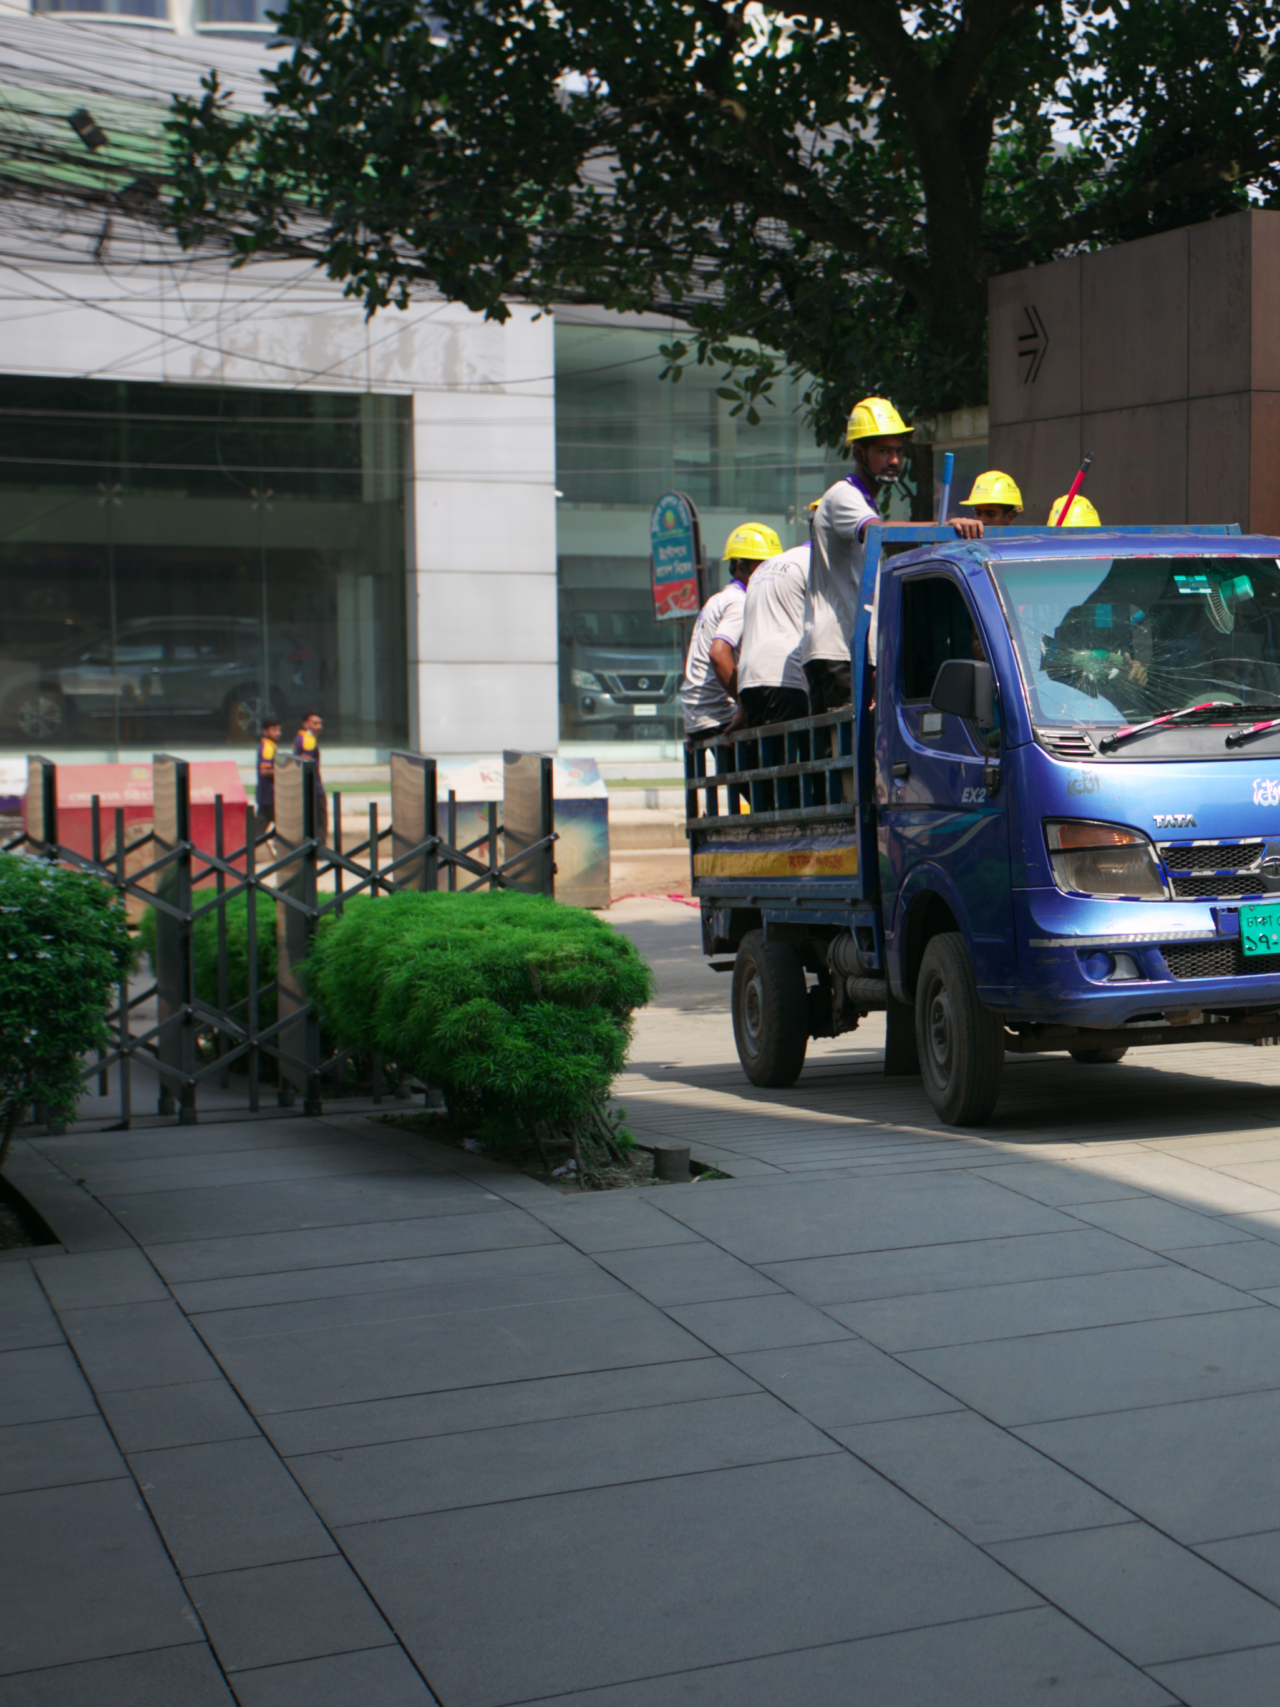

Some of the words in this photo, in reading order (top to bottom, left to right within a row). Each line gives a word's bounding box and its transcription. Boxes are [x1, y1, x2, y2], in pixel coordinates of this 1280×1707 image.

[961, 787, 988, 803] EX2
[1152, 814, 1198, 828] TATA
[1246, 914, 1272, 928] ঢাকা
